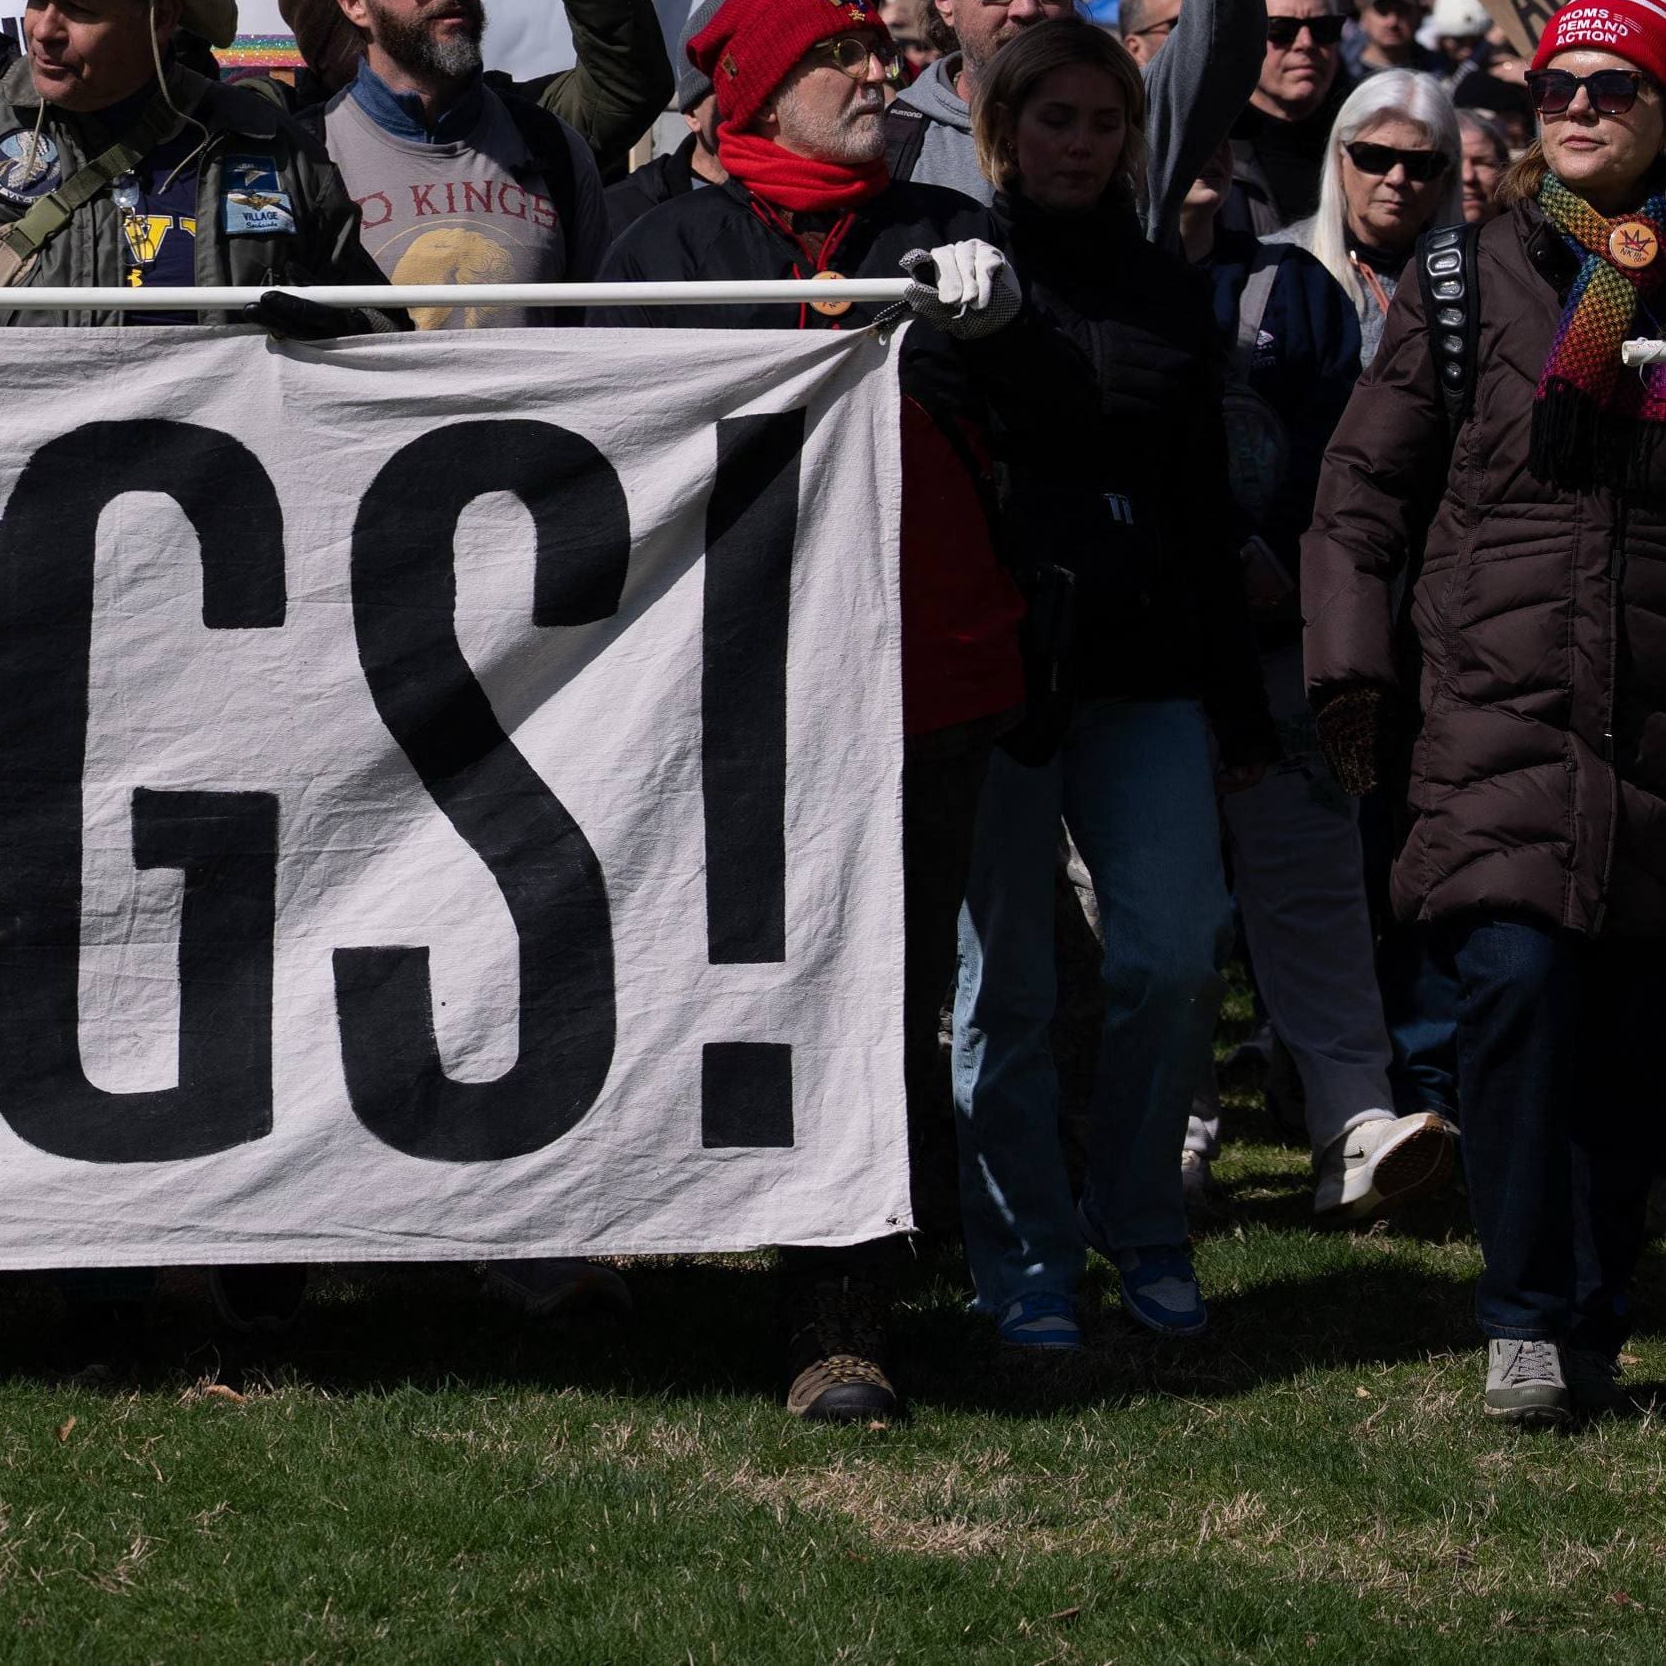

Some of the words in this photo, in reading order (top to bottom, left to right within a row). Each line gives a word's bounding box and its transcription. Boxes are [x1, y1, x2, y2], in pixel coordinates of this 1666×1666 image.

[1559, 8, 1609, 23] MOMS
[1558, 19, 1628, 36] DEMAND
[1556, 32, 1617, 46] ACTION
[409, 180, 558, 232] KINGS
[243, 212, 278, 221] VILLAGE
